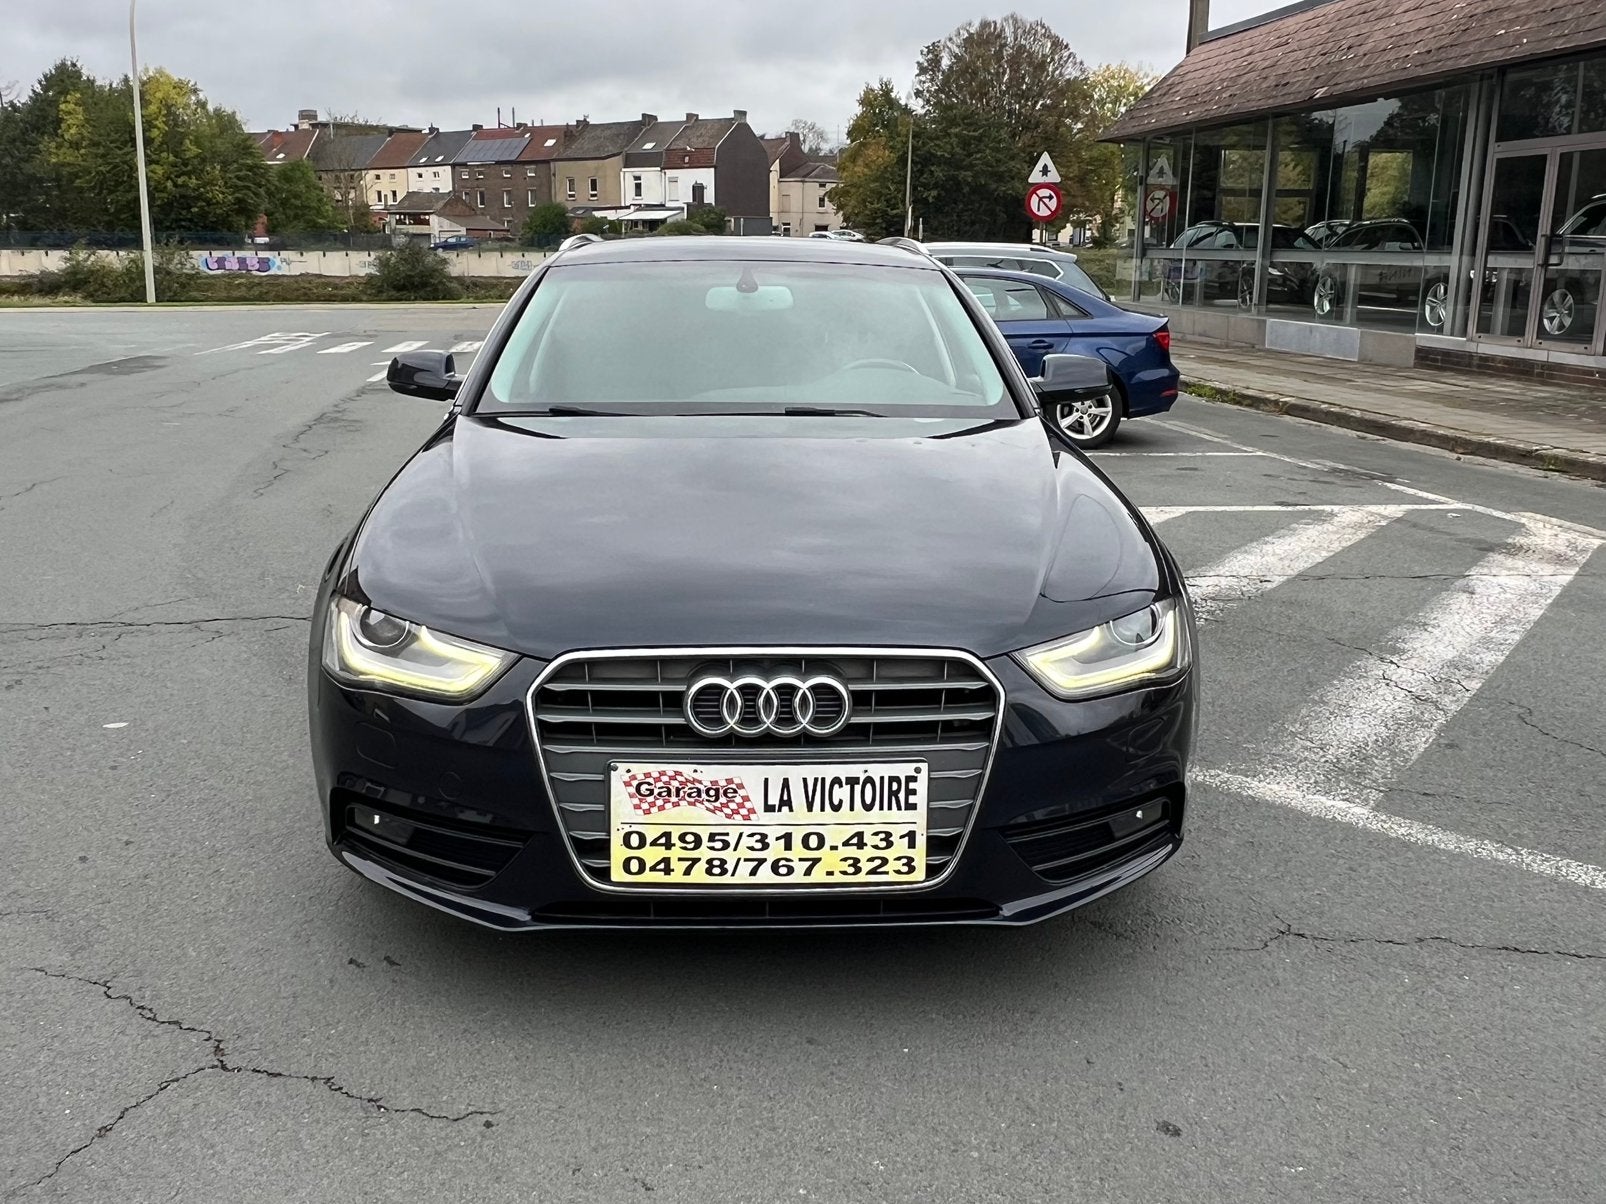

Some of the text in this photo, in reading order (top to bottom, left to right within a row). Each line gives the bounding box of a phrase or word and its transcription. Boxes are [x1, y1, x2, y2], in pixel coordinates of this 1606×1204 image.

[634, 775, 918, 813] Garage LA VICTOIRE
[622, 830, 917, 852] 0495/310.431
[622, 856, 917, 877] 0478/767.323
